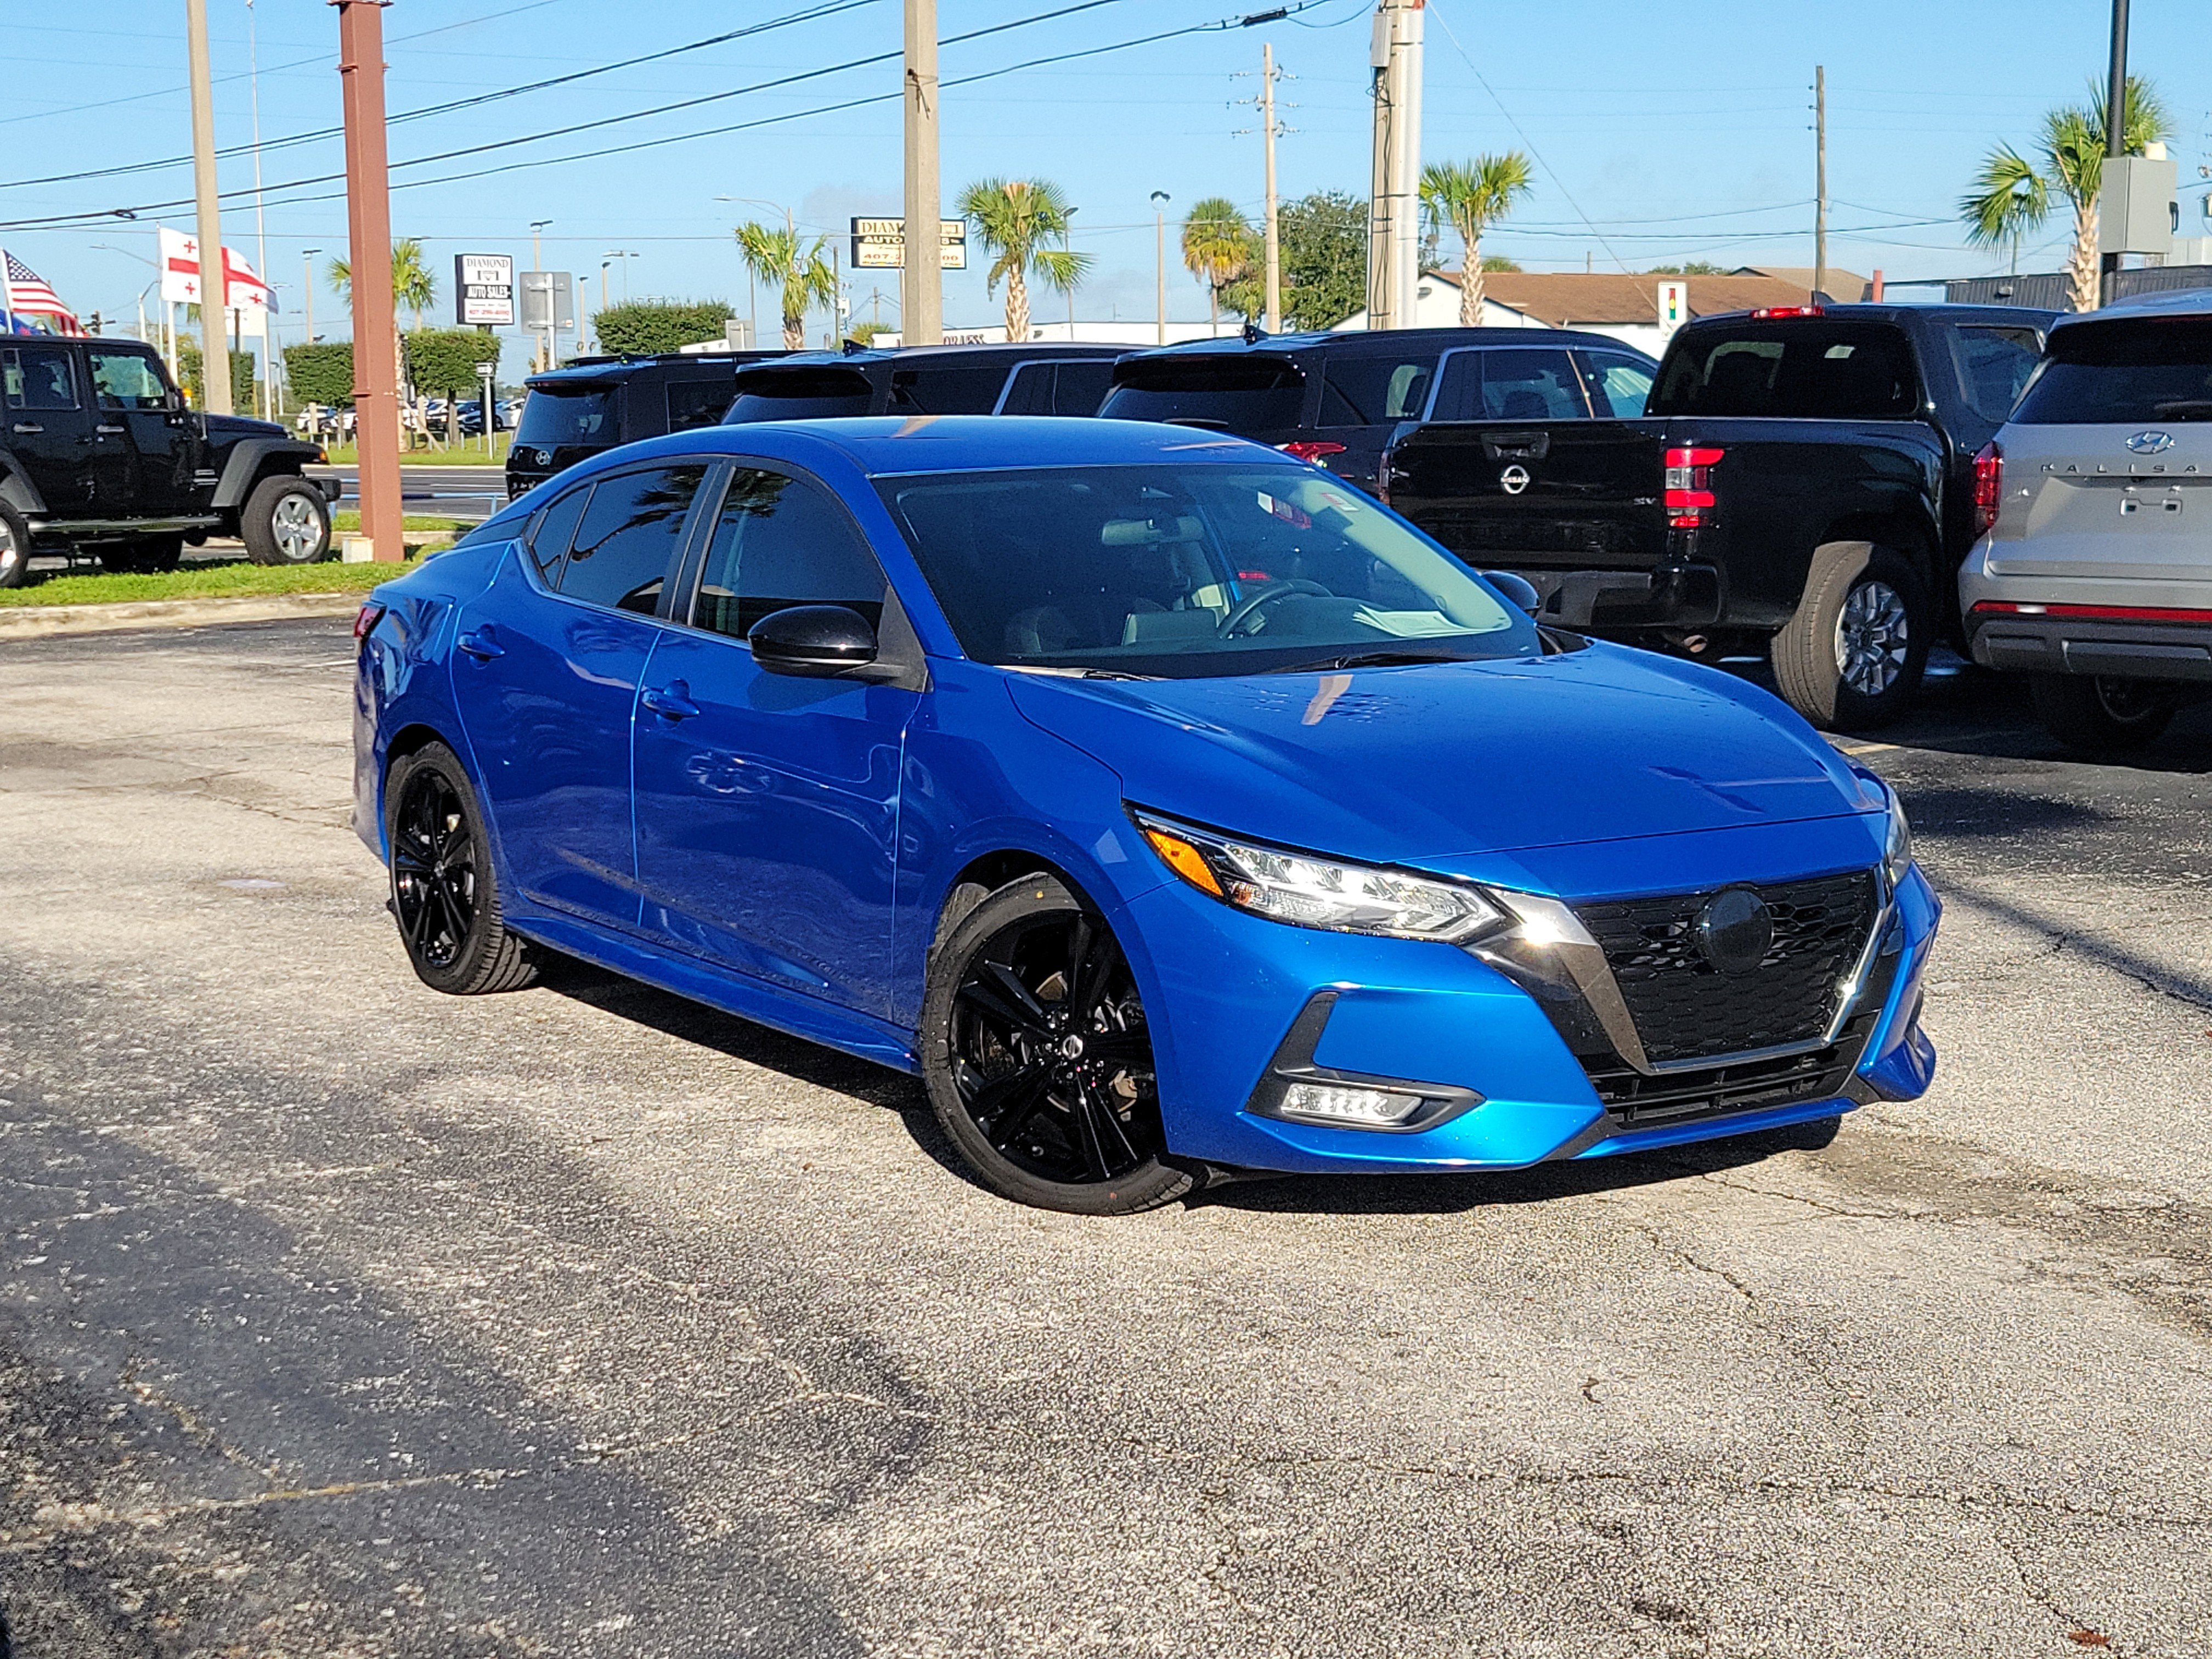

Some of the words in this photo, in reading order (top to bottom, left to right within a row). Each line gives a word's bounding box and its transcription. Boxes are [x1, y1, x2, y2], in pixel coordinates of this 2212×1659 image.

[864, 236, 902, 244] AUTO
[466, 258, 509, 268] DIAMOND
[467, 285, 486, 298] AUTO
[487, 285, 508, 298] SALES
[1634, 496, 1656, 505] SV
